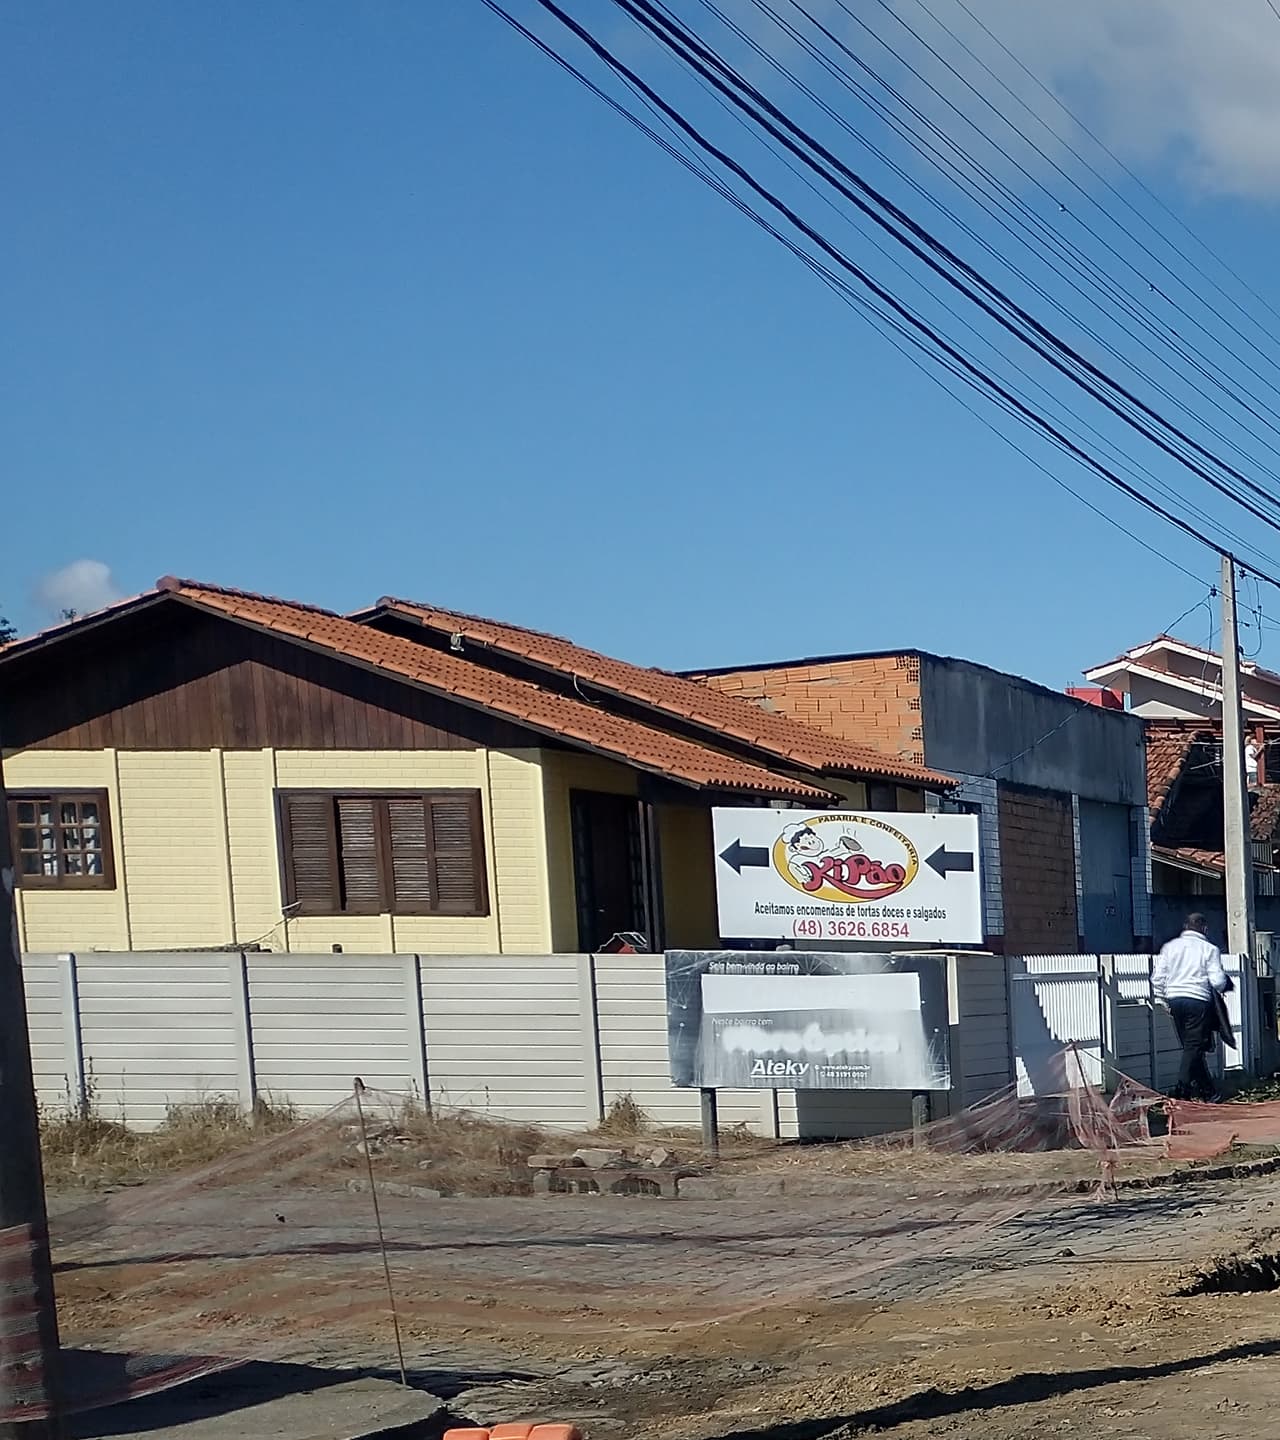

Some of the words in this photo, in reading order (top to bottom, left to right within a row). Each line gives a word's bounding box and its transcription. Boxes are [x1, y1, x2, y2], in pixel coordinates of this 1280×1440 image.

[817, 814, 859, 824] PADARIA
[754, 901, 795, 915] Aceitamos
[796, 903, 844, 917] encomendas
[845, 904, 856, 917] de
[857, 905, 881, 918] tortas
[881, 905, 906, 919] doces
[906, 909, 912, 918] e
[913, 906, 947, 922] salgados
[792, 919, 823, 937] (48)
[827, 920, 910, 938] 3626.6854
[750, 1058, 810, 1076] Ateky
